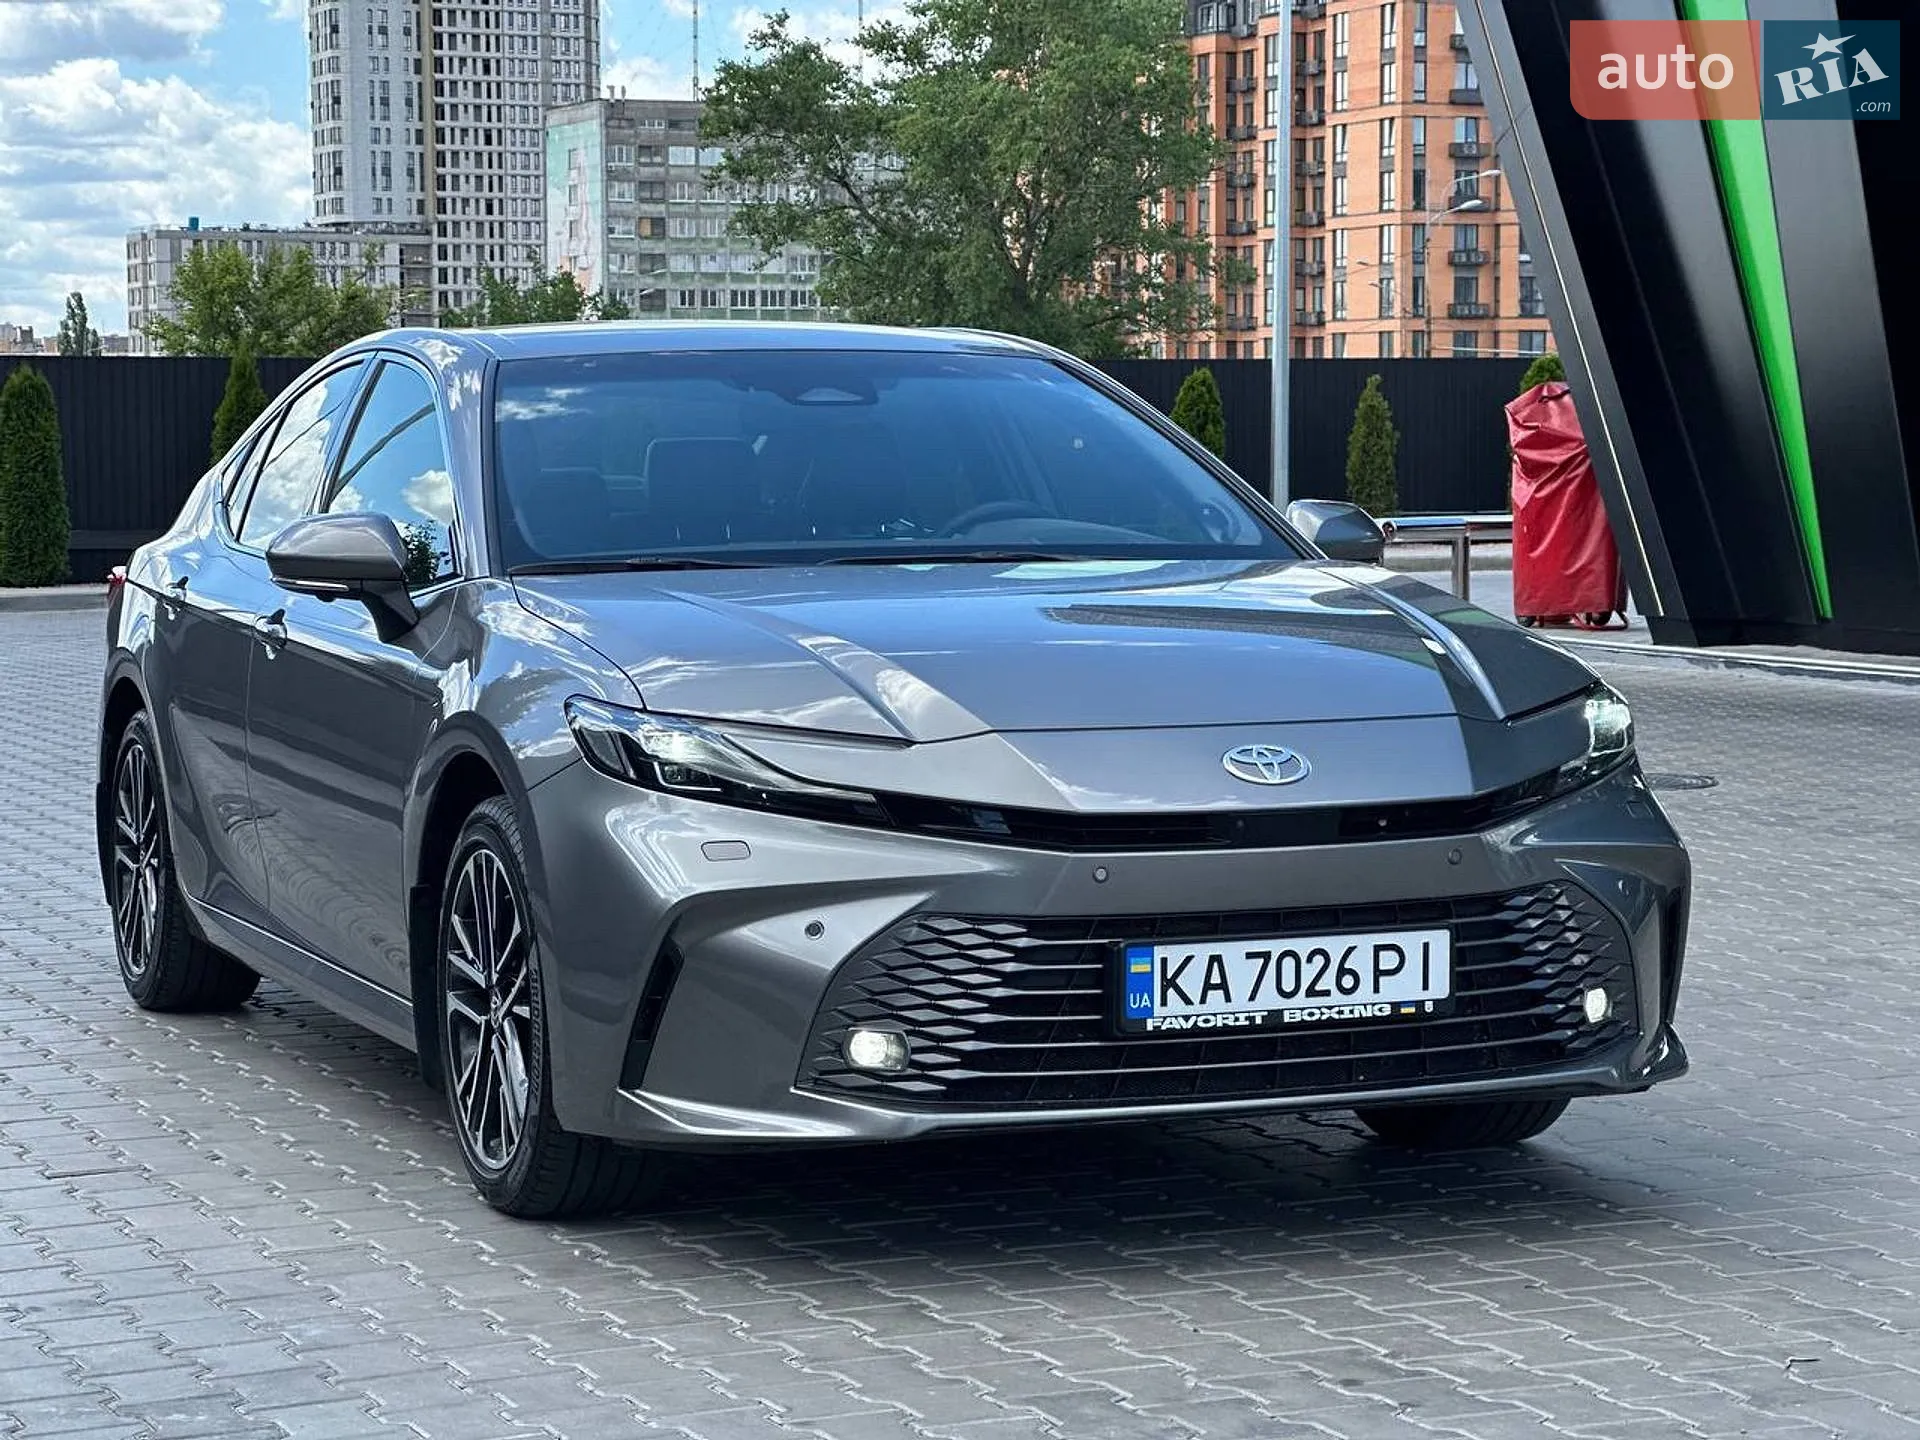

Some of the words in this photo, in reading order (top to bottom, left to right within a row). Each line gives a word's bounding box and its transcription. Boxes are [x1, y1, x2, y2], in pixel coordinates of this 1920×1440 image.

[1159, 954, 1232, 1007] KA
[1245, 945, 1361, 1002] 7026
[1130, 993, 1151, 1009] UA
[1146, 1011, 1268, 1031] FAVORIT
[1283, 1003, 1392, 1023] BOXING
